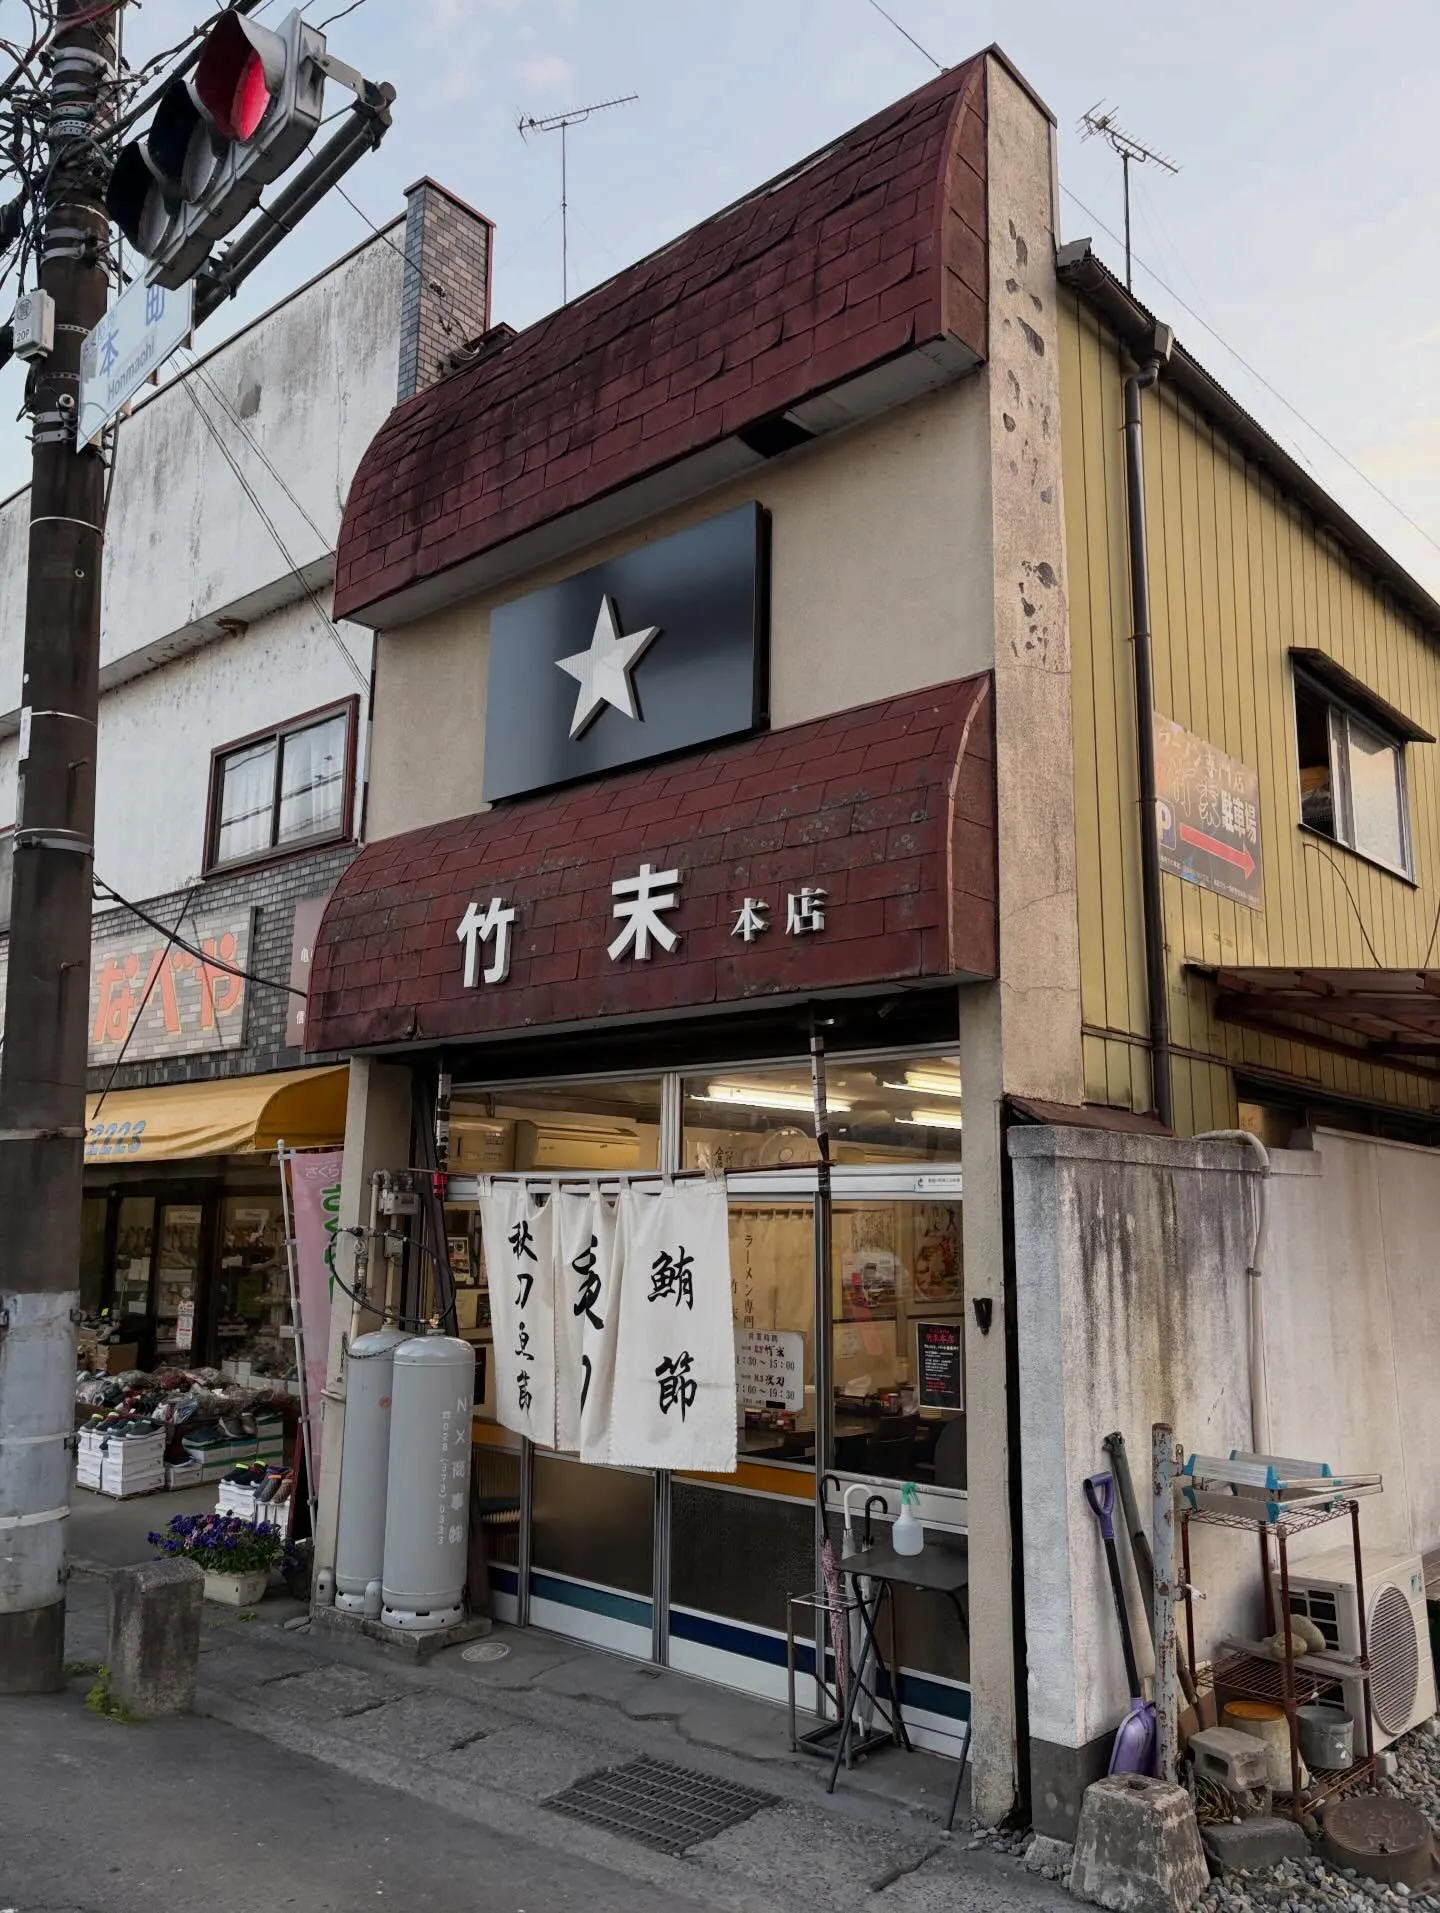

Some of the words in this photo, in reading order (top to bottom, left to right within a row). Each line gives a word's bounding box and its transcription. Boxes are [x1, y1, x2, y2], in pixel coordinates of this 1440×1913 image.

[107, 335, 155, 402] Honmachi
[1220, 787, 1257, 845] 駐車場
[730, 888, 829, 943] 本店
[92, 931, 245, 1044] なべや
